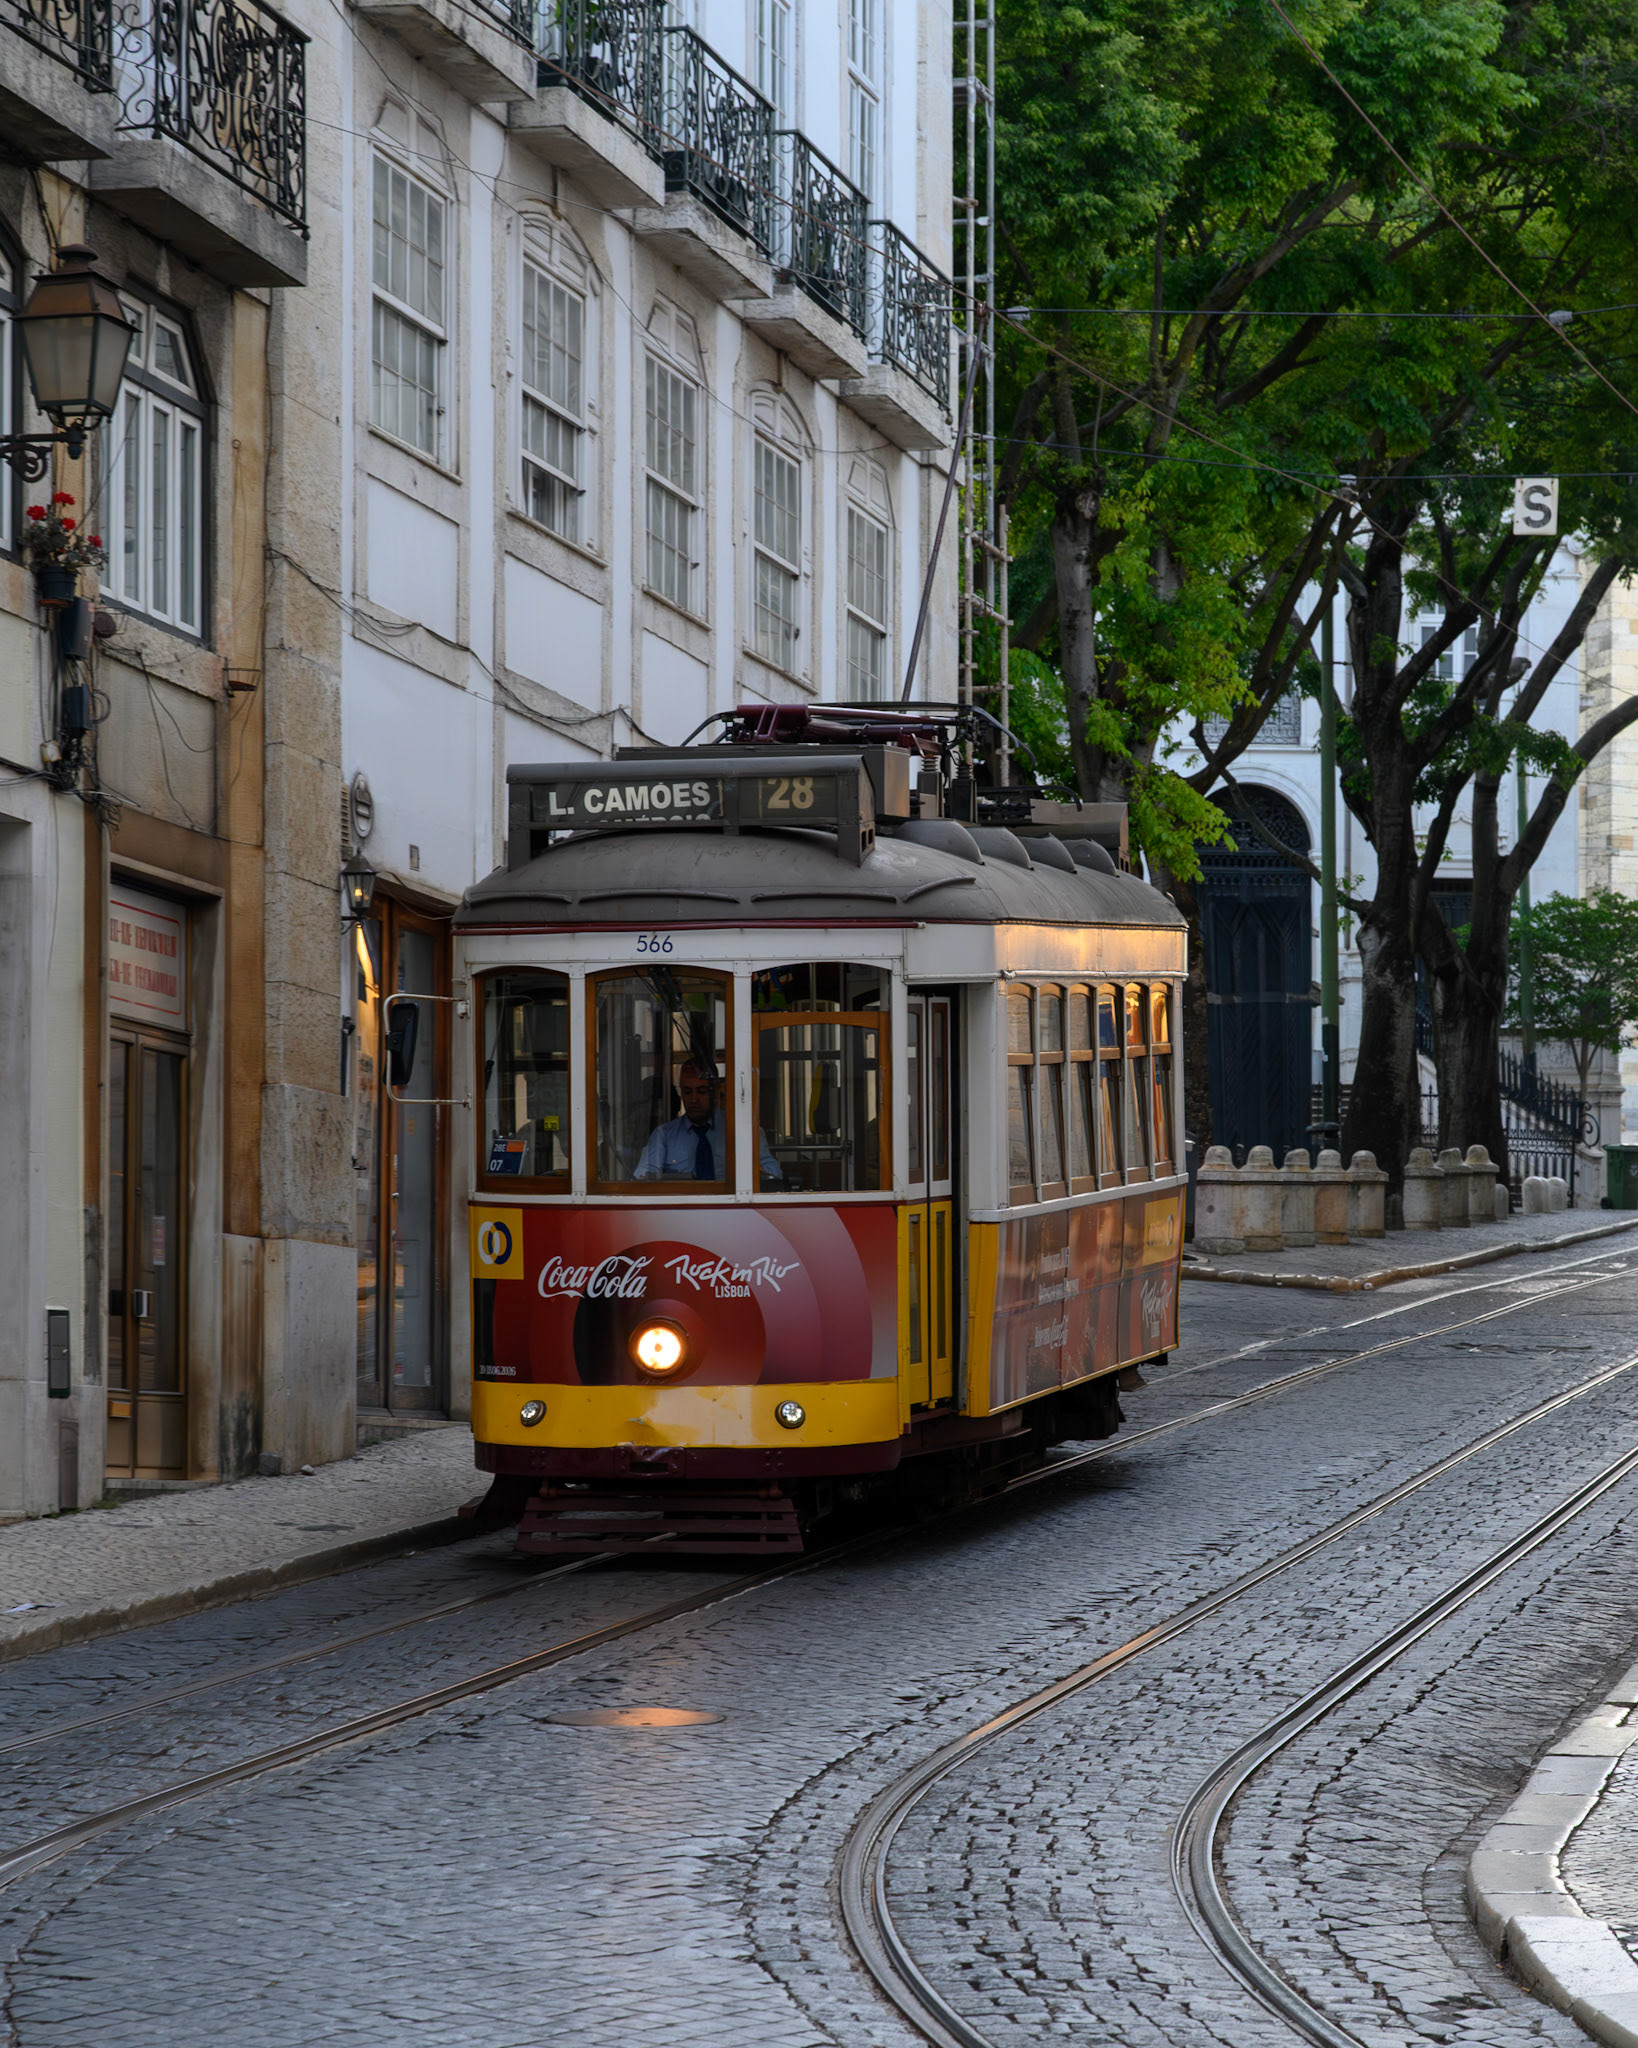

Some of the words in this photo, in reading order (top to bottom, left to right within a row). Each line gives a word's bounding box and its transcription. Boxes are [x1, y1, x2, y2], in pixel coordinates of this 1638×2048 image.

[1522, 485, 1552, 529] S
[549, 792, 575, 816] L.
[767, 777, 815, 810] 28
[636, 935, 674, 953] 566
[493, 1143, 507, 1152] 28E
[489, 1159, 504, 1172] 07
[538, 1255, 655, 1299] Coca-Cola
[664, 1254, 730, 1291] Rock
[730, 1263, 752, 1282] in
[750, 1256, 801, 1293] Rio
[715, 1284, 750, 1298] LISBOA
